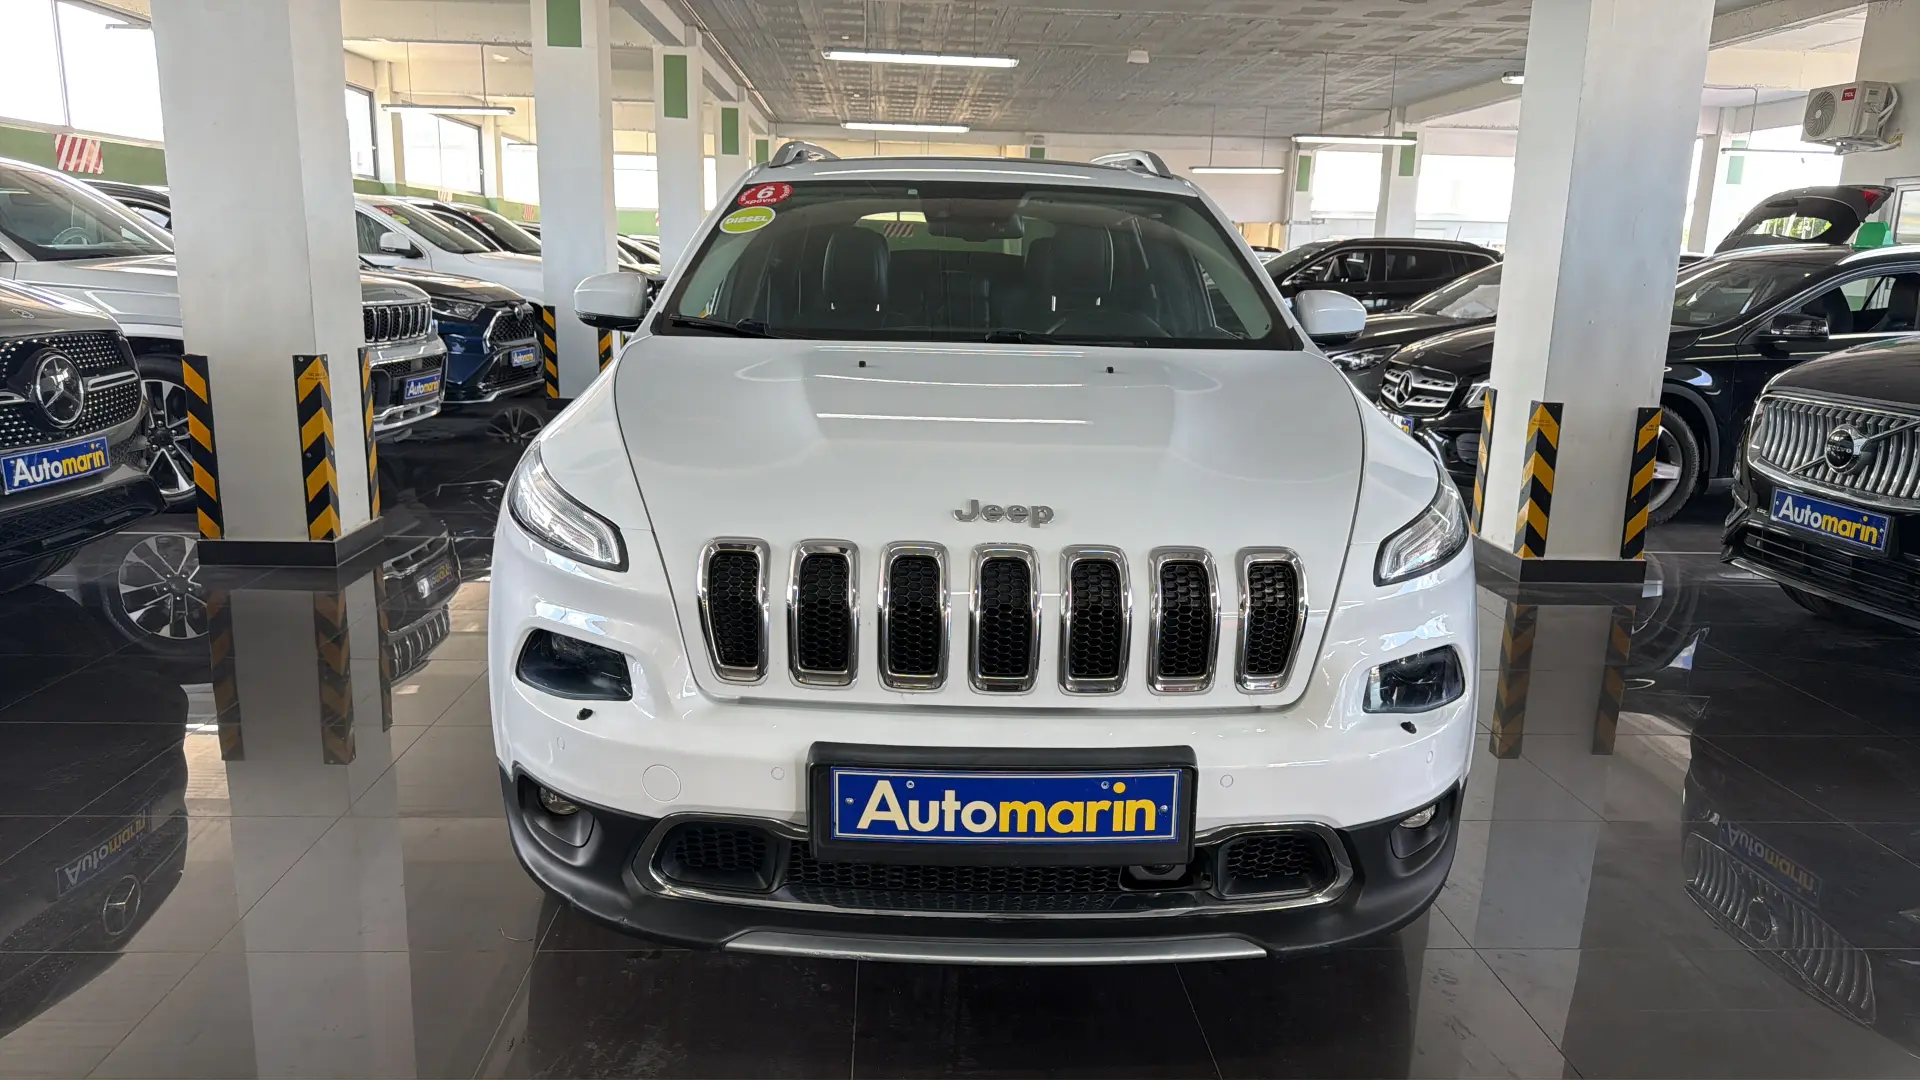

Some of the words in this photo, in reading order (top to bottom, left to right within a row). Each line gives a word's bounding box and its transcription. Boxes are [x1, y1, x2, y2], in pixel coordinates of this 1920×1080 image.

[757, 187, 775, 199] 6
[724, 215, 768, 225] DIESEL
[407, 376, 440, 397] Automarin
[13, 443, 106, 487] Automarin
[953, 499, 1055, 529] Jeep
[1778, 495, 1878, 545] Automarin
[856, 779, 1157, 834] Automarin
